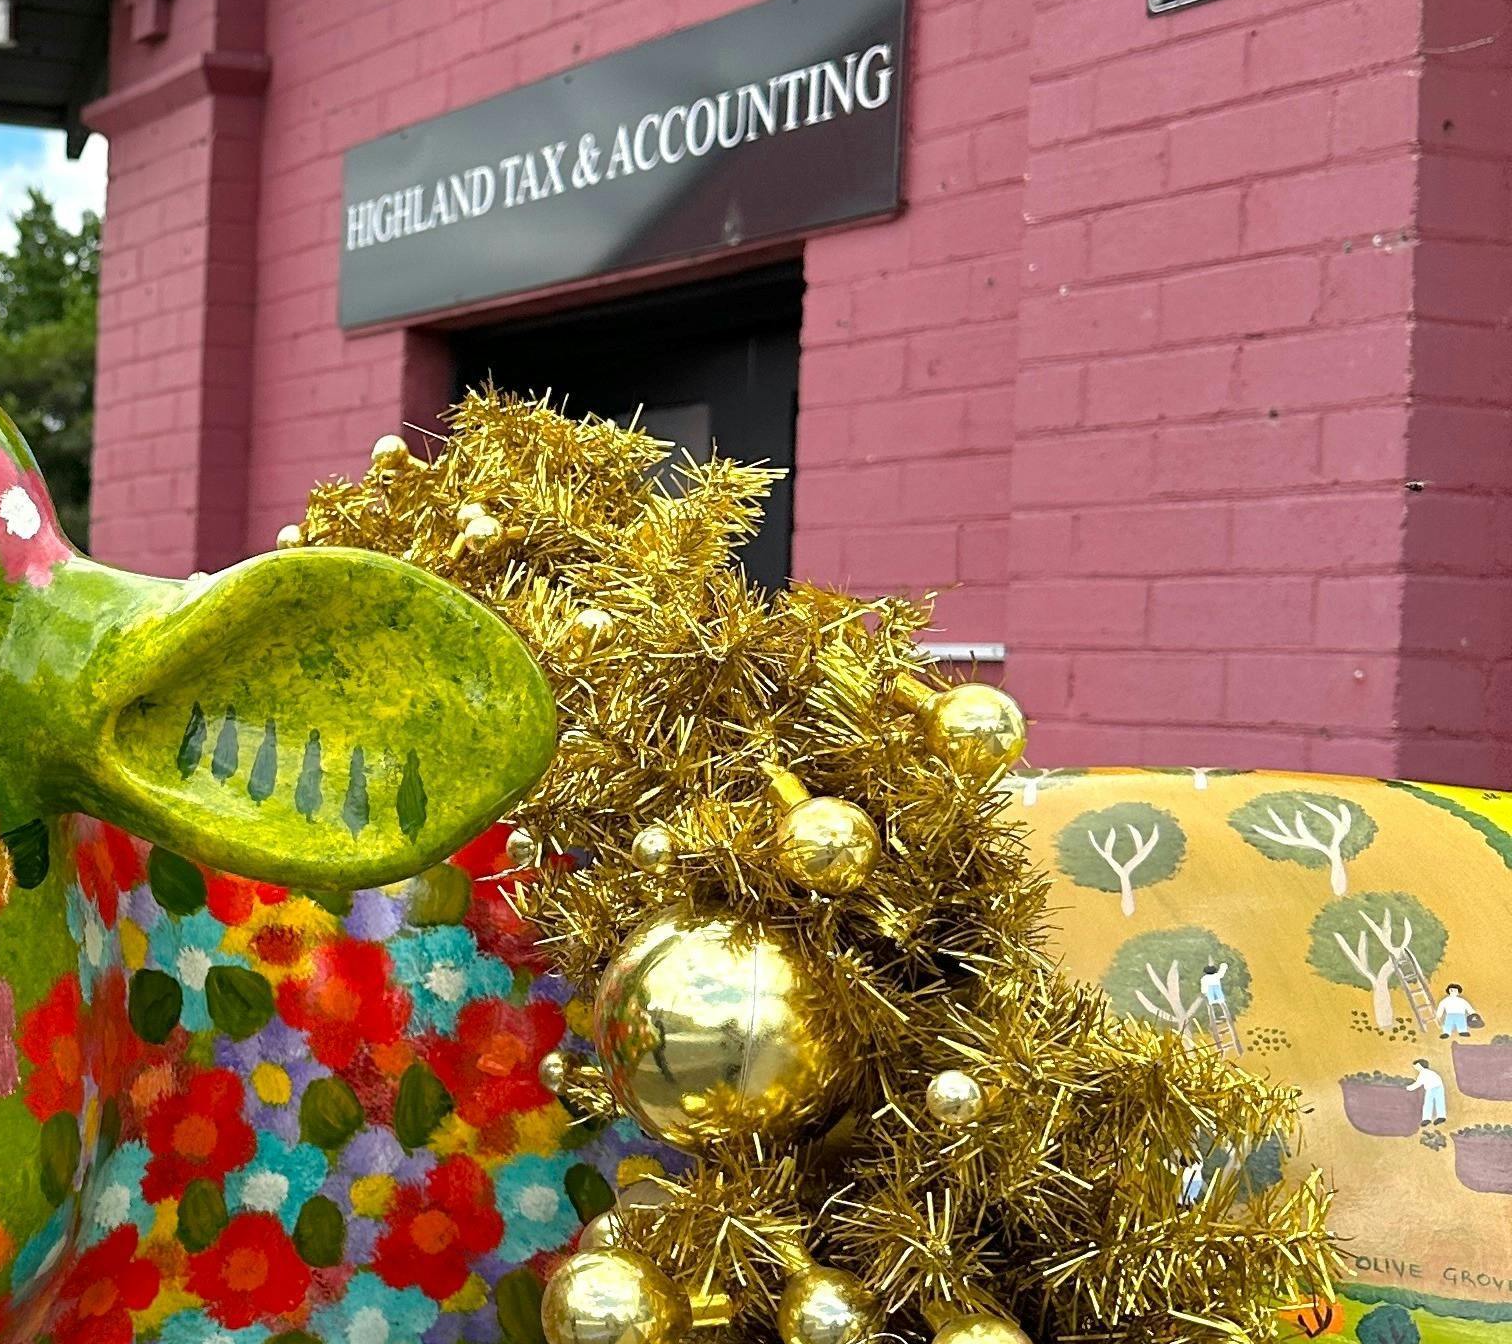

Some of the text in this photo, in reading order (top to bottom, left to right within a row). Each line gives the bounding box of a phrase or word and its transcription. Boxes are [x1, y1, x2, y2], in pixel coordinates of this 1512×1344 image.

[346, 43, 894, 251] HIGHLAND TAX & ACCOUNTING
[1355, 1255, 1512, 1292] OLIVE GROV
